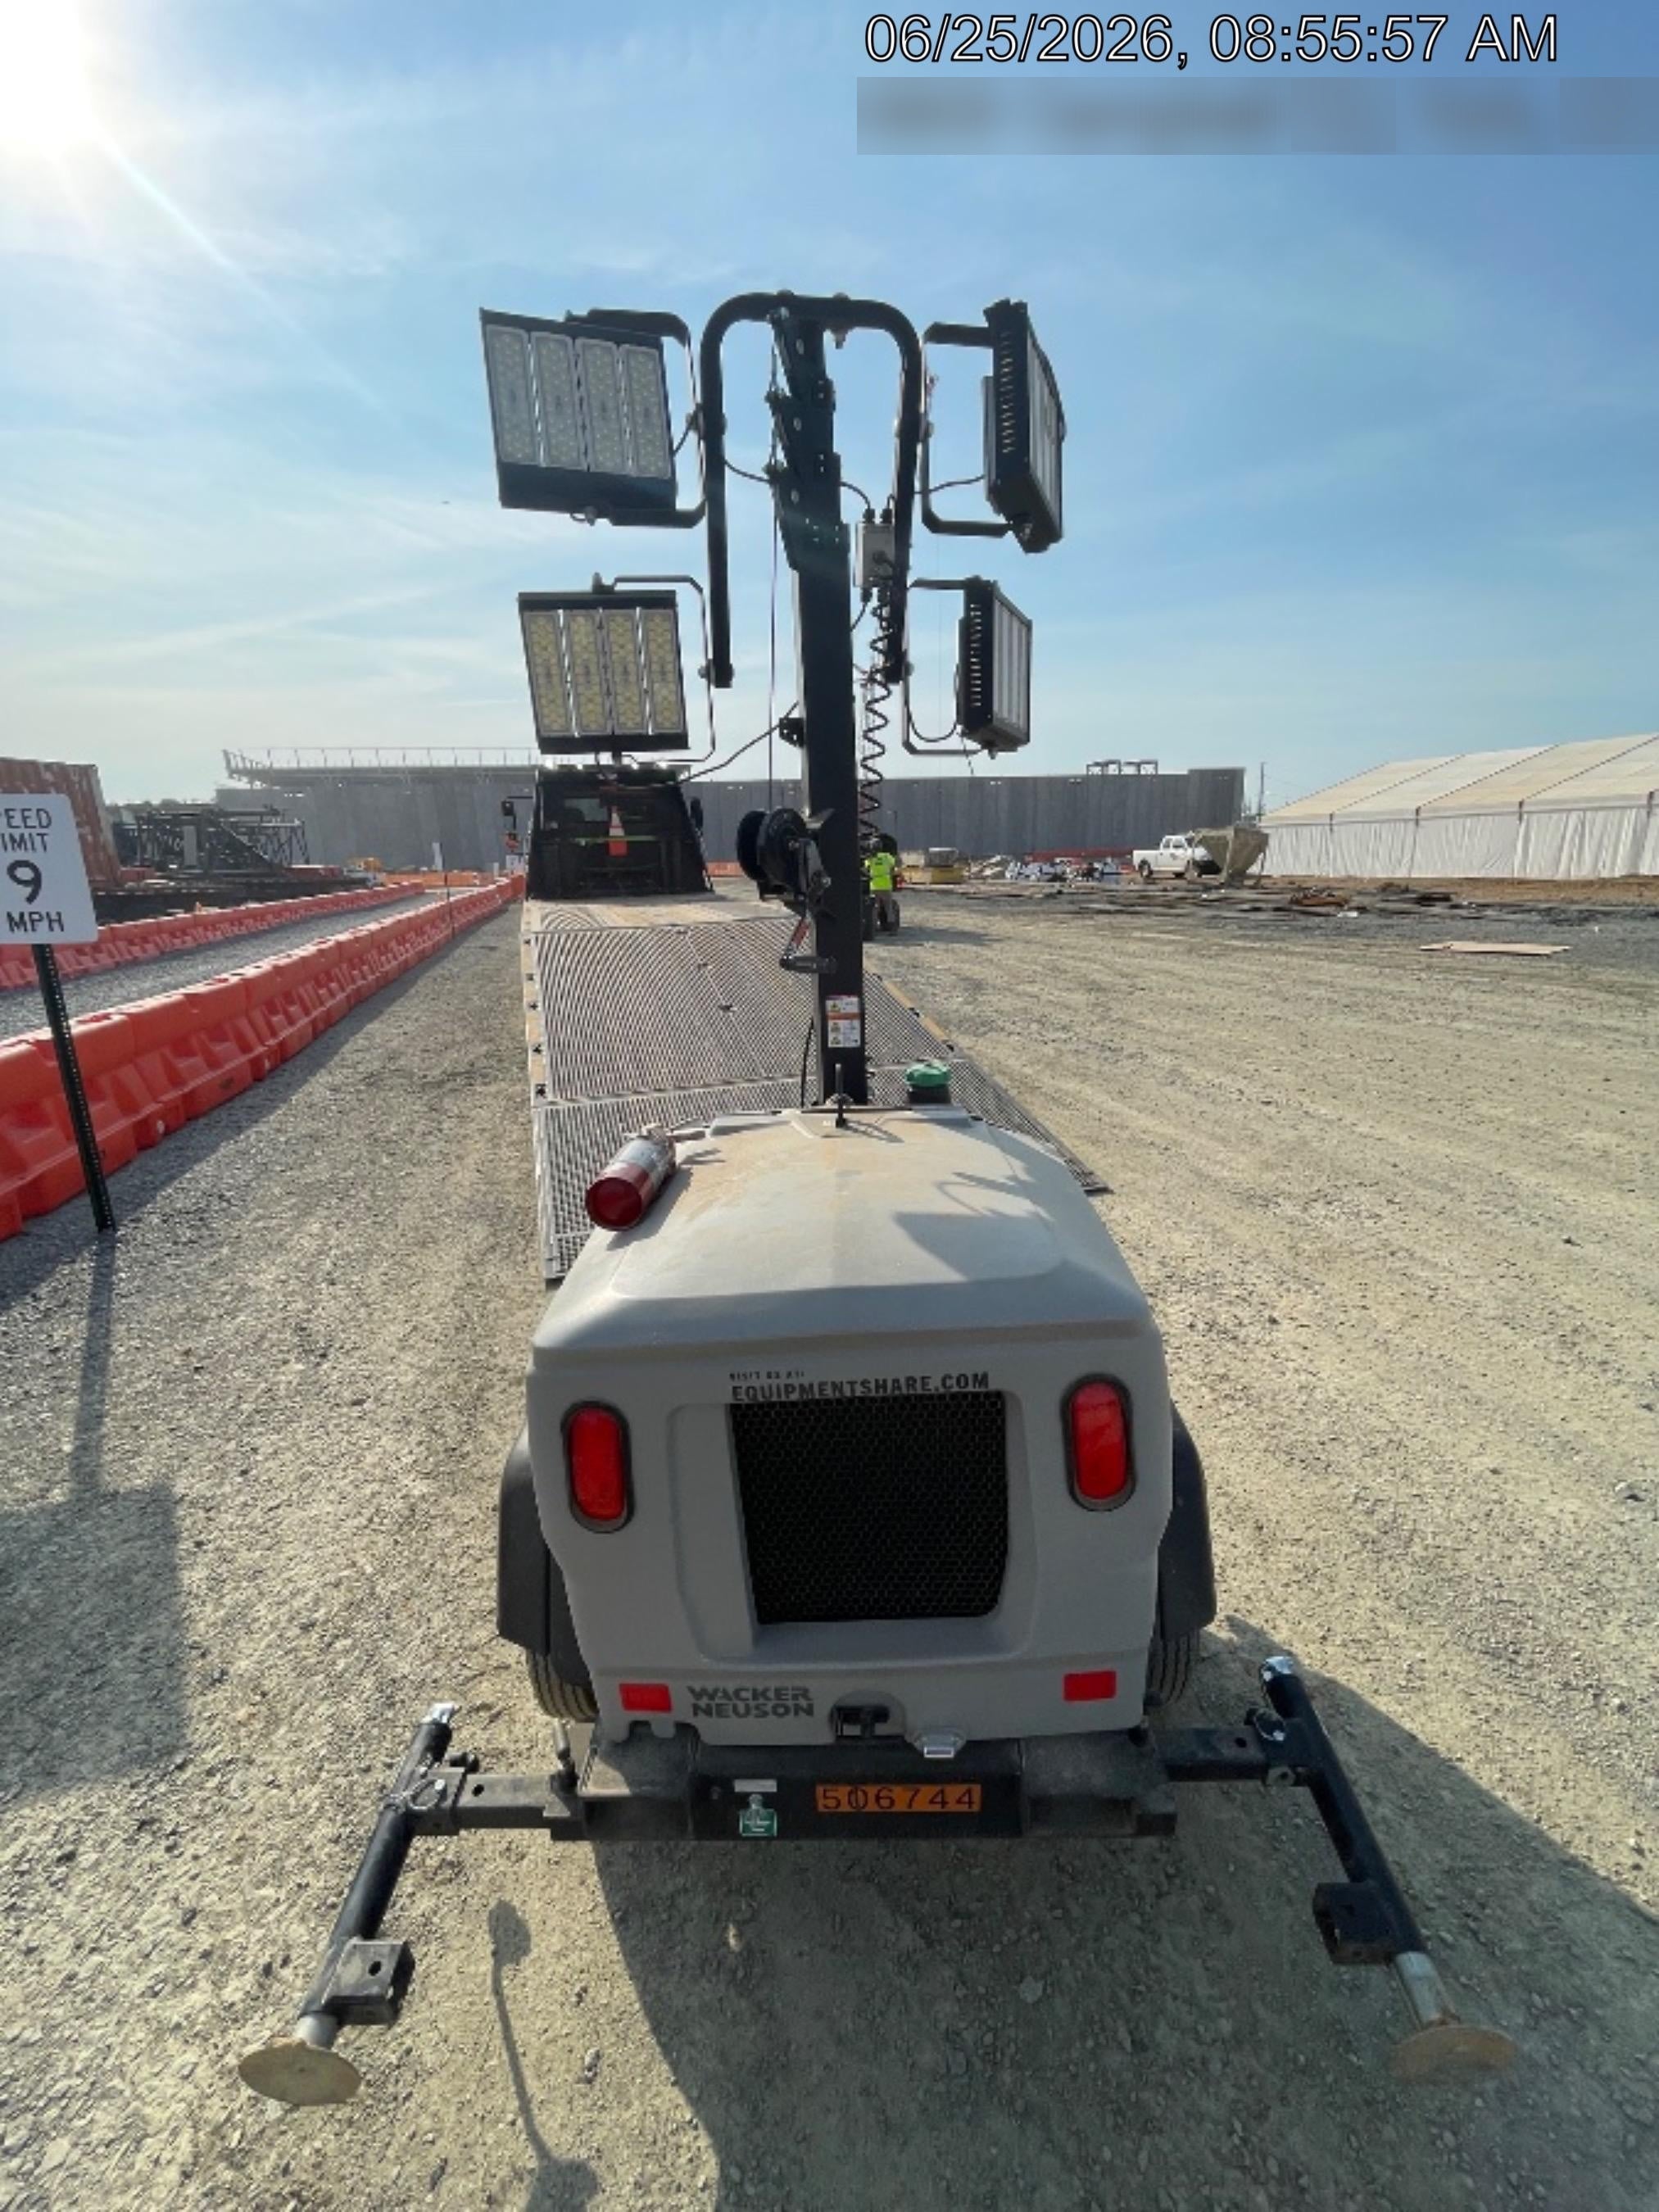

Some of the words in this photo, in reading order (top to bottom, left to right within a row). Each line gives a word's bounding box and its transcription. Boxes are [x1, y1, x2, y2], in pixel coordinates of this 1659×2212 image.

[0, 807, 52, 829] EED
[0, 832, 49, 853] IMIT
[7, 859, 43, 904] 9
[7, 910, 65, 932] MPH
[731, 1371, 990, 1403] EQUIPMENTSHARE.COM
[686, 1685, 813, 1702] WACKER
[691, 1702, 814, 1719] NEUSON
[821, 1786, 976, 1811] 506744
